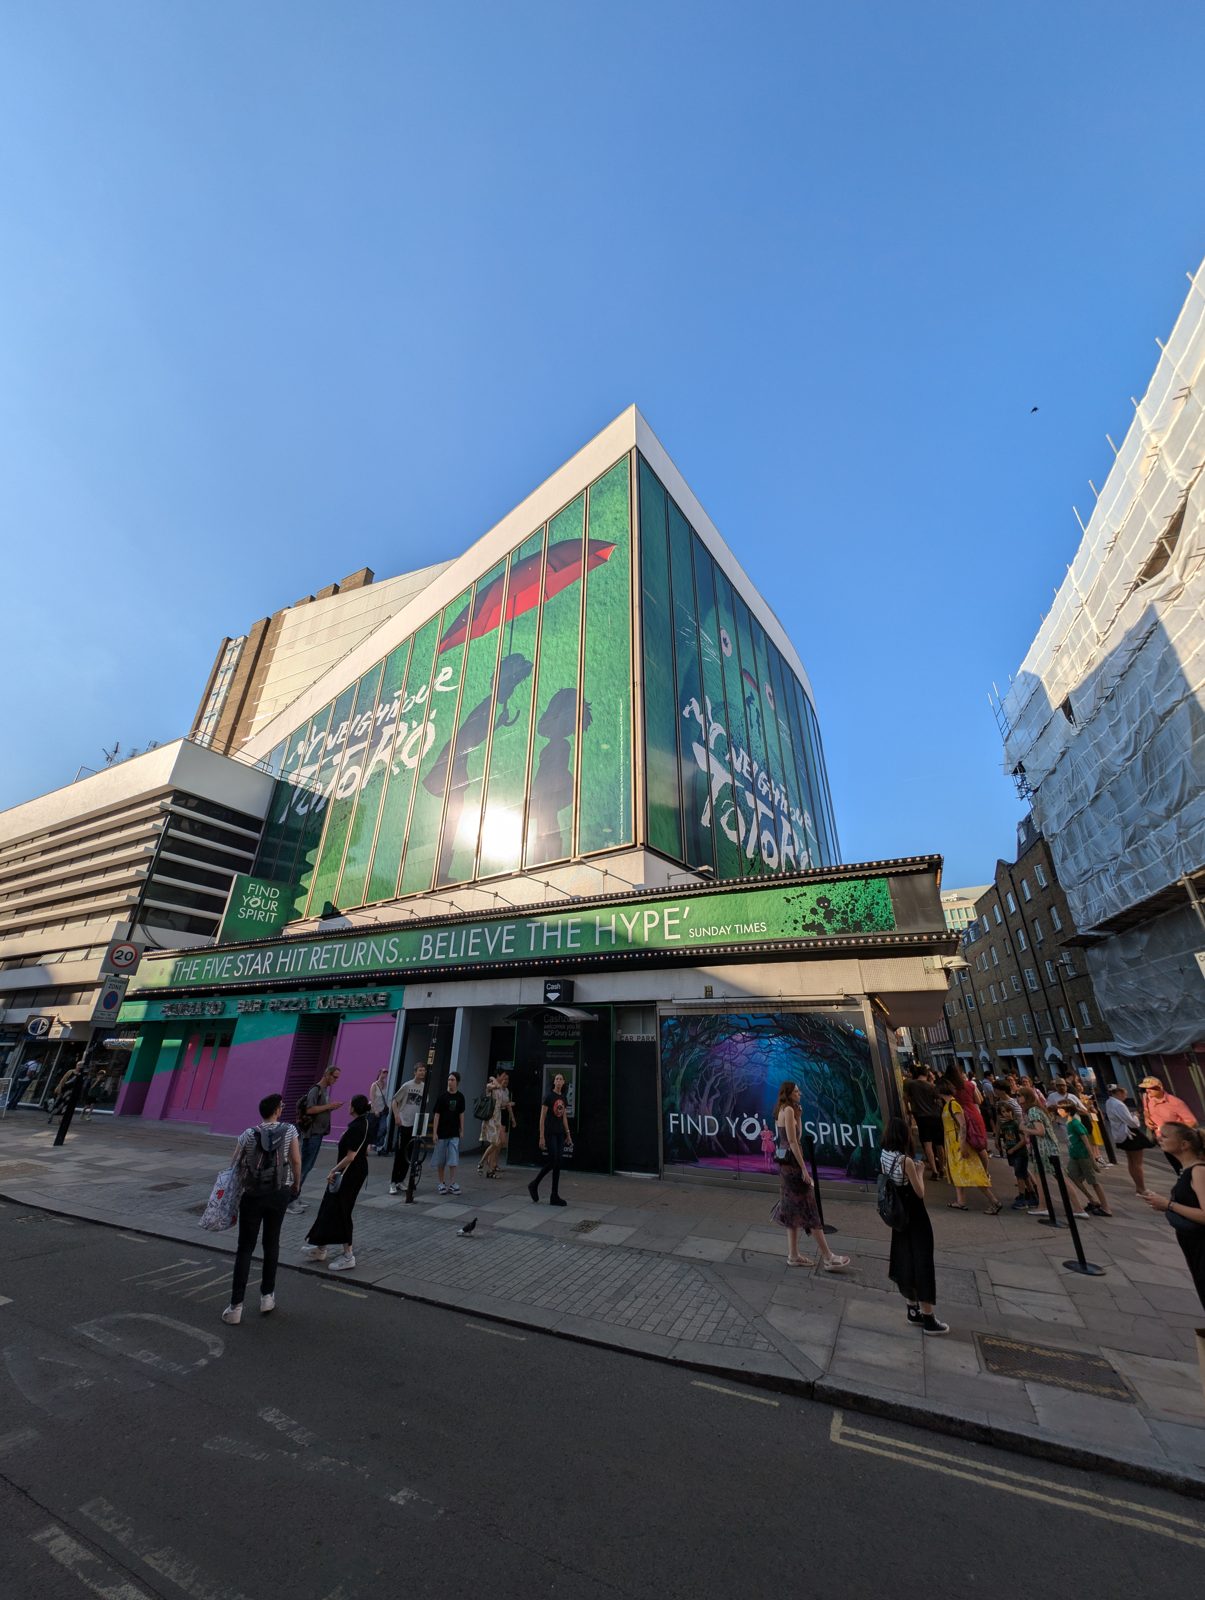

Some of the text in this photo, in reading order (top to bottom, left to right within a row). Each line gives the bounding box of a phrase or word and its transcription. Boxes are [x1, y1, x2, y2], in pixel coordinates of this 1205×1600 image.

[247, 883, 280, 899] FIND
[242, 895, 279, 912] YOUR
[237, 907, 278, 924] SPIRIT
[114, 949, 134, 962] 20
[173, 959, 201, 982] THE
[201, 955, 233, 979] FIVE
[233, 951, 274, 977] STAR
[275, 947, 308, 973] HIT
[526, 918, 582, 951] THE
[688, 924, 732, 938] SUNDAY
[734, 922, 767, 935] TIMES
[108, 983, 122, 991] ZONE
[268, 997, 309, 1011] PIZZA
[669, 1113, 719, 1136] FIND
[804, 1120, 877, 1148] SPIRIT
